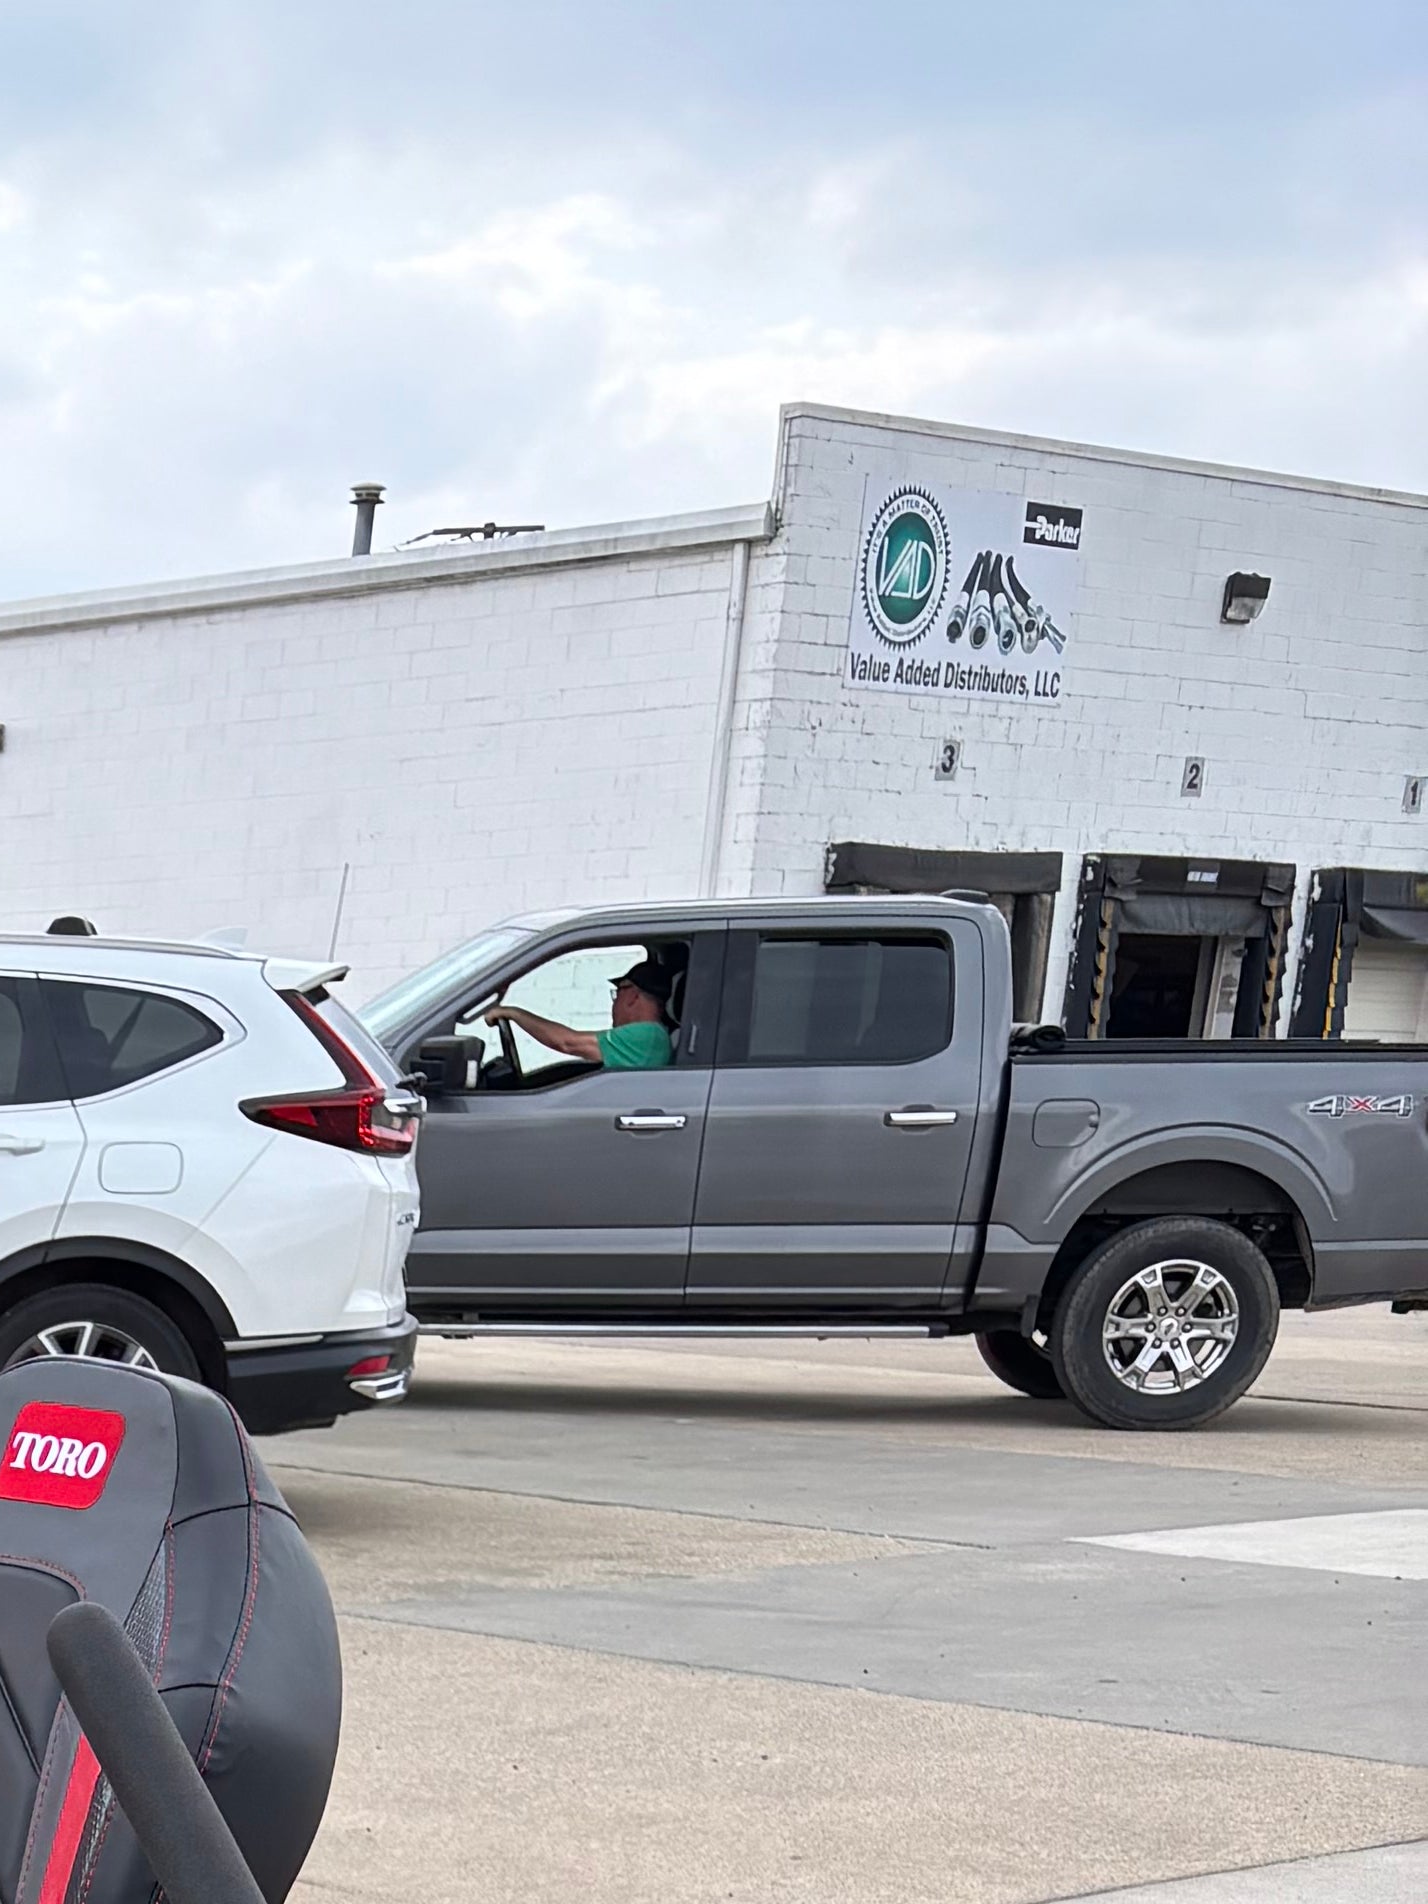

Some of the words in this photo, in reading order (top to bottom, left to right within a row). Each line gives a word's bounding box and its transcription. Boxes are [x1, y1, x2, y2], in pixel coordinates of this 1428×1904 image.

[1034, 514, 1081, 545] Parker
[850, 652, 891, 683] Value
[894, 656, 942, 688] Added
[944, 662, 1030, 701] Distributors,
[1033, 670, 1061, 698] LLC
[941, 744, 955, 773] 3
[1186, 763, 1200, 790] 2
[1410, 780, 1419, 806] 1
[9, 1431, 108, 1480] TORO
